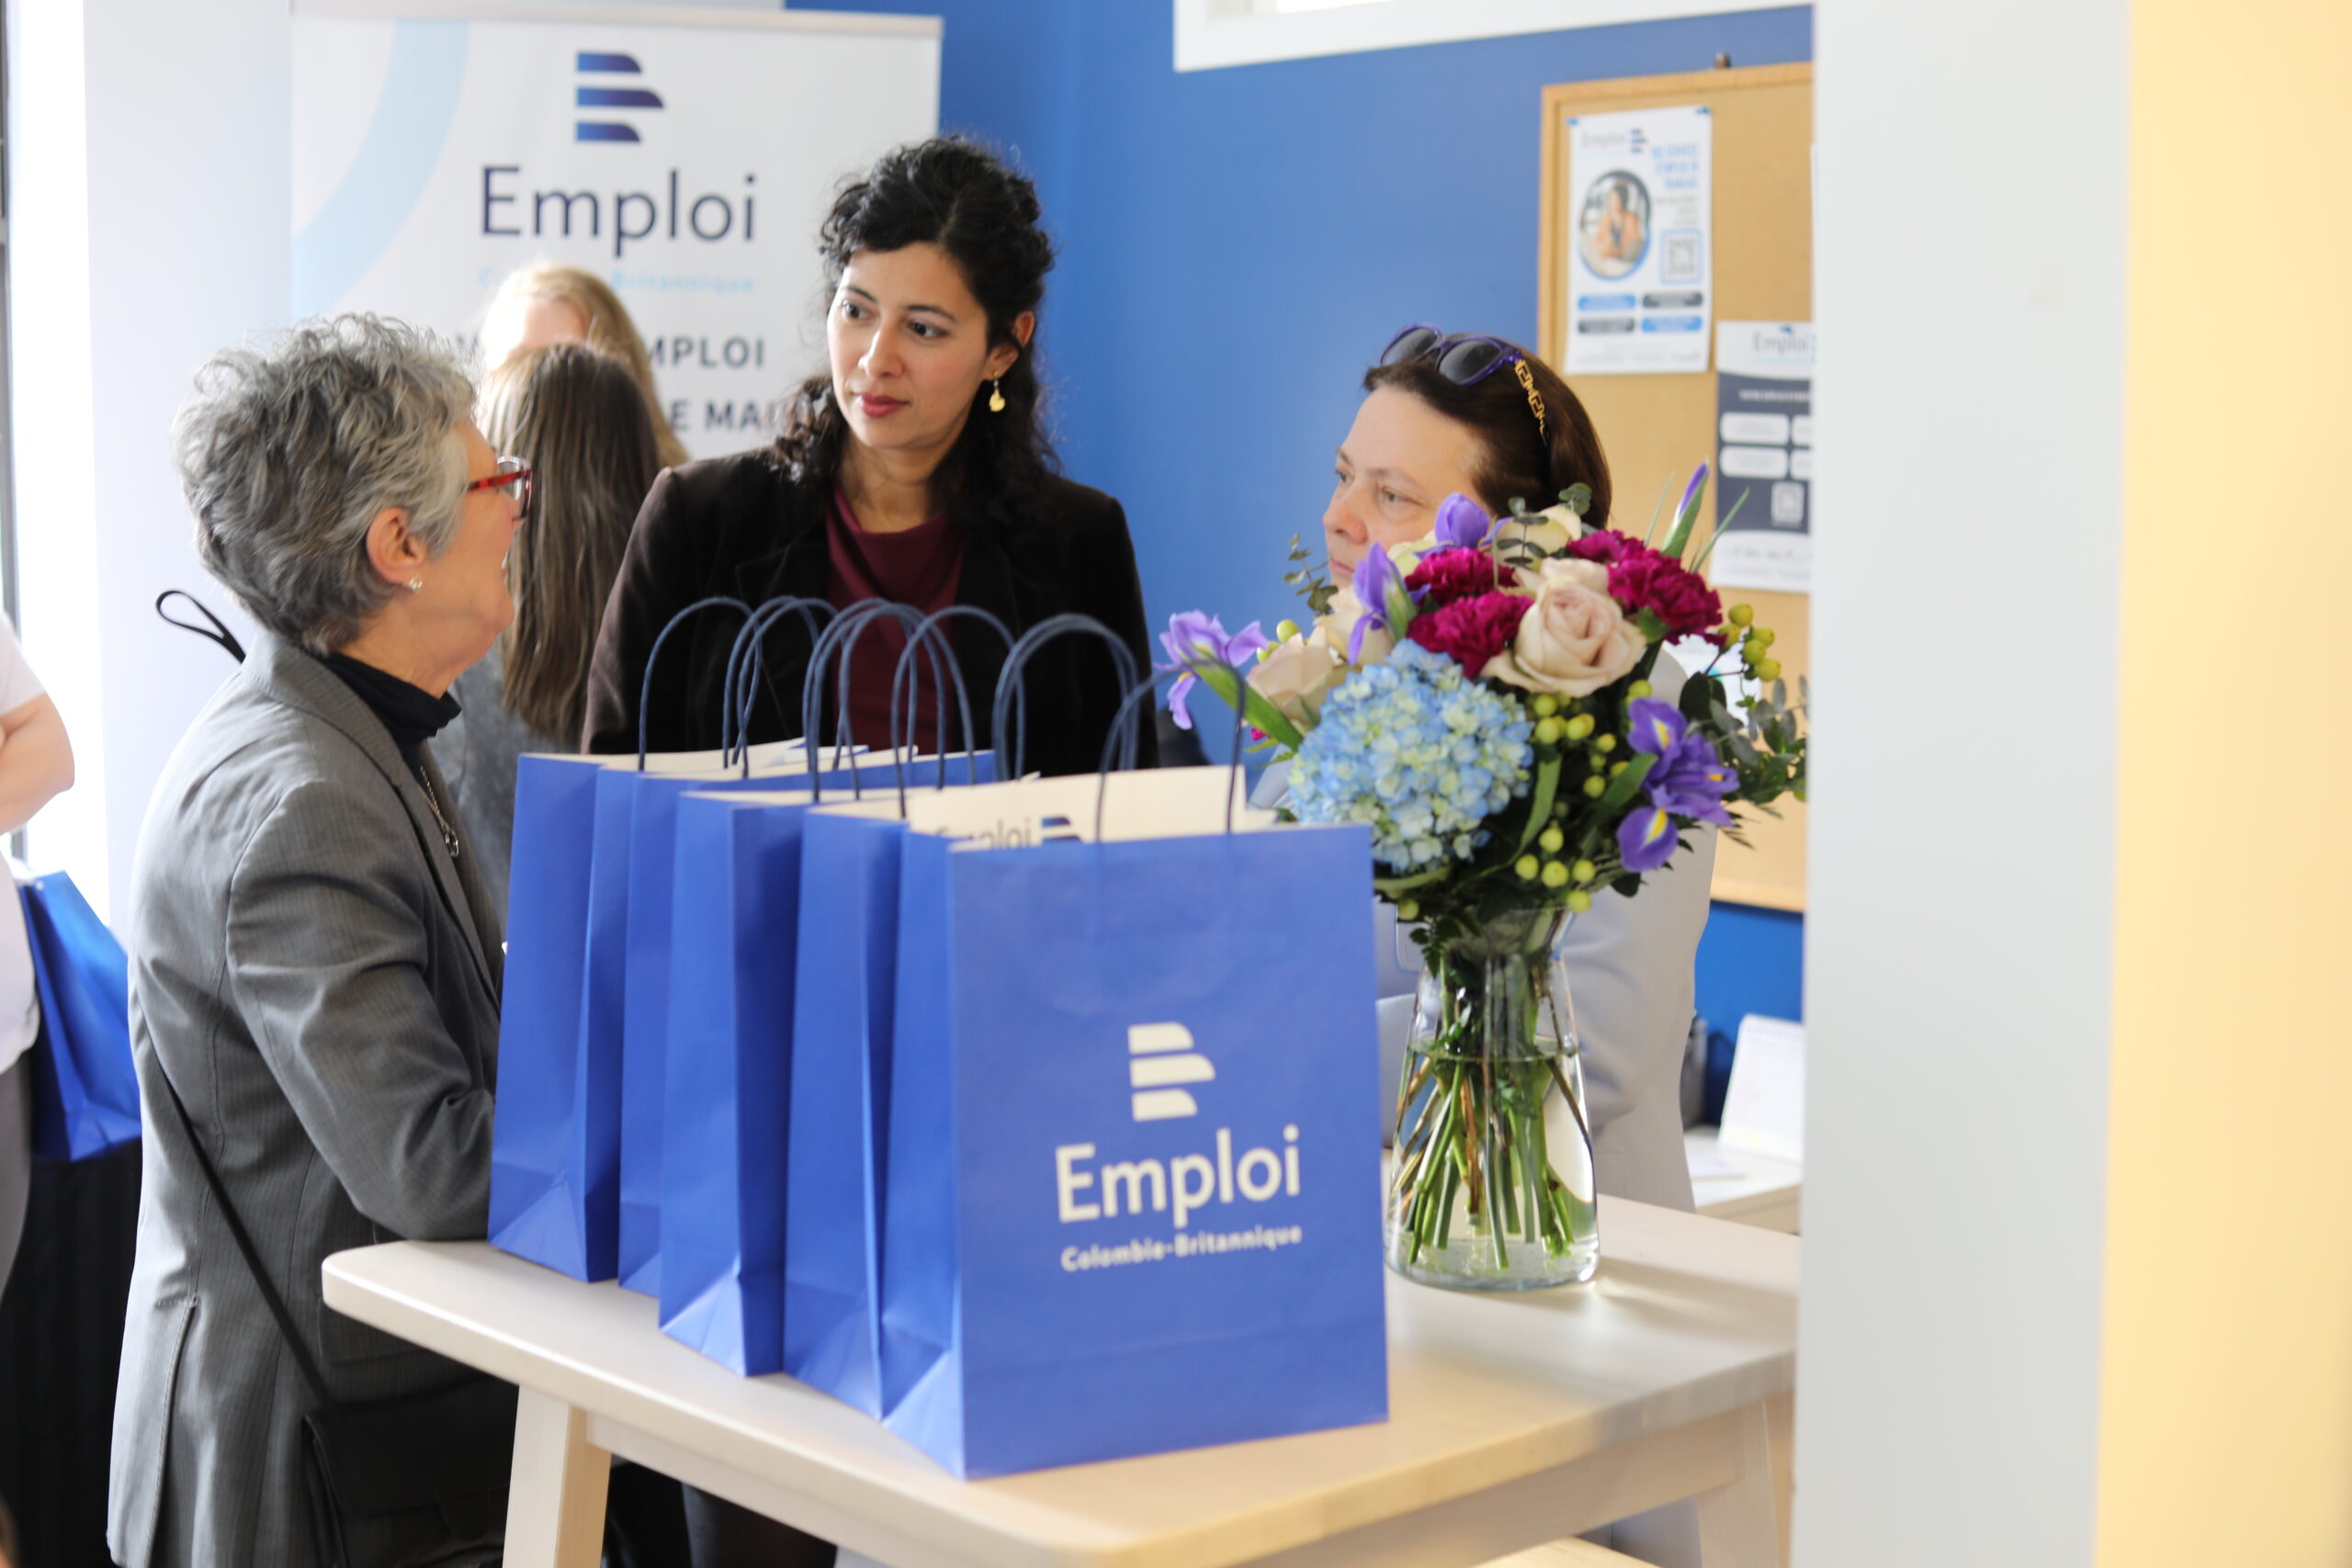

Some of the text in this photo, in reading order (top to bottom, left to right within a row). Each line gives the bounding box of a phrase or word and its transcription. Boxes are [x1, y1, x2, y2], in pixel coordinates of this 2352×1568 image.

[481, 164, 757, 257] Emploi
[647, 335, 764, 368] MPLOI
[1056, 1123, 1300, 1229] Emploi
[1060, 1224, 1303, 1272] Colombie-Britannique
